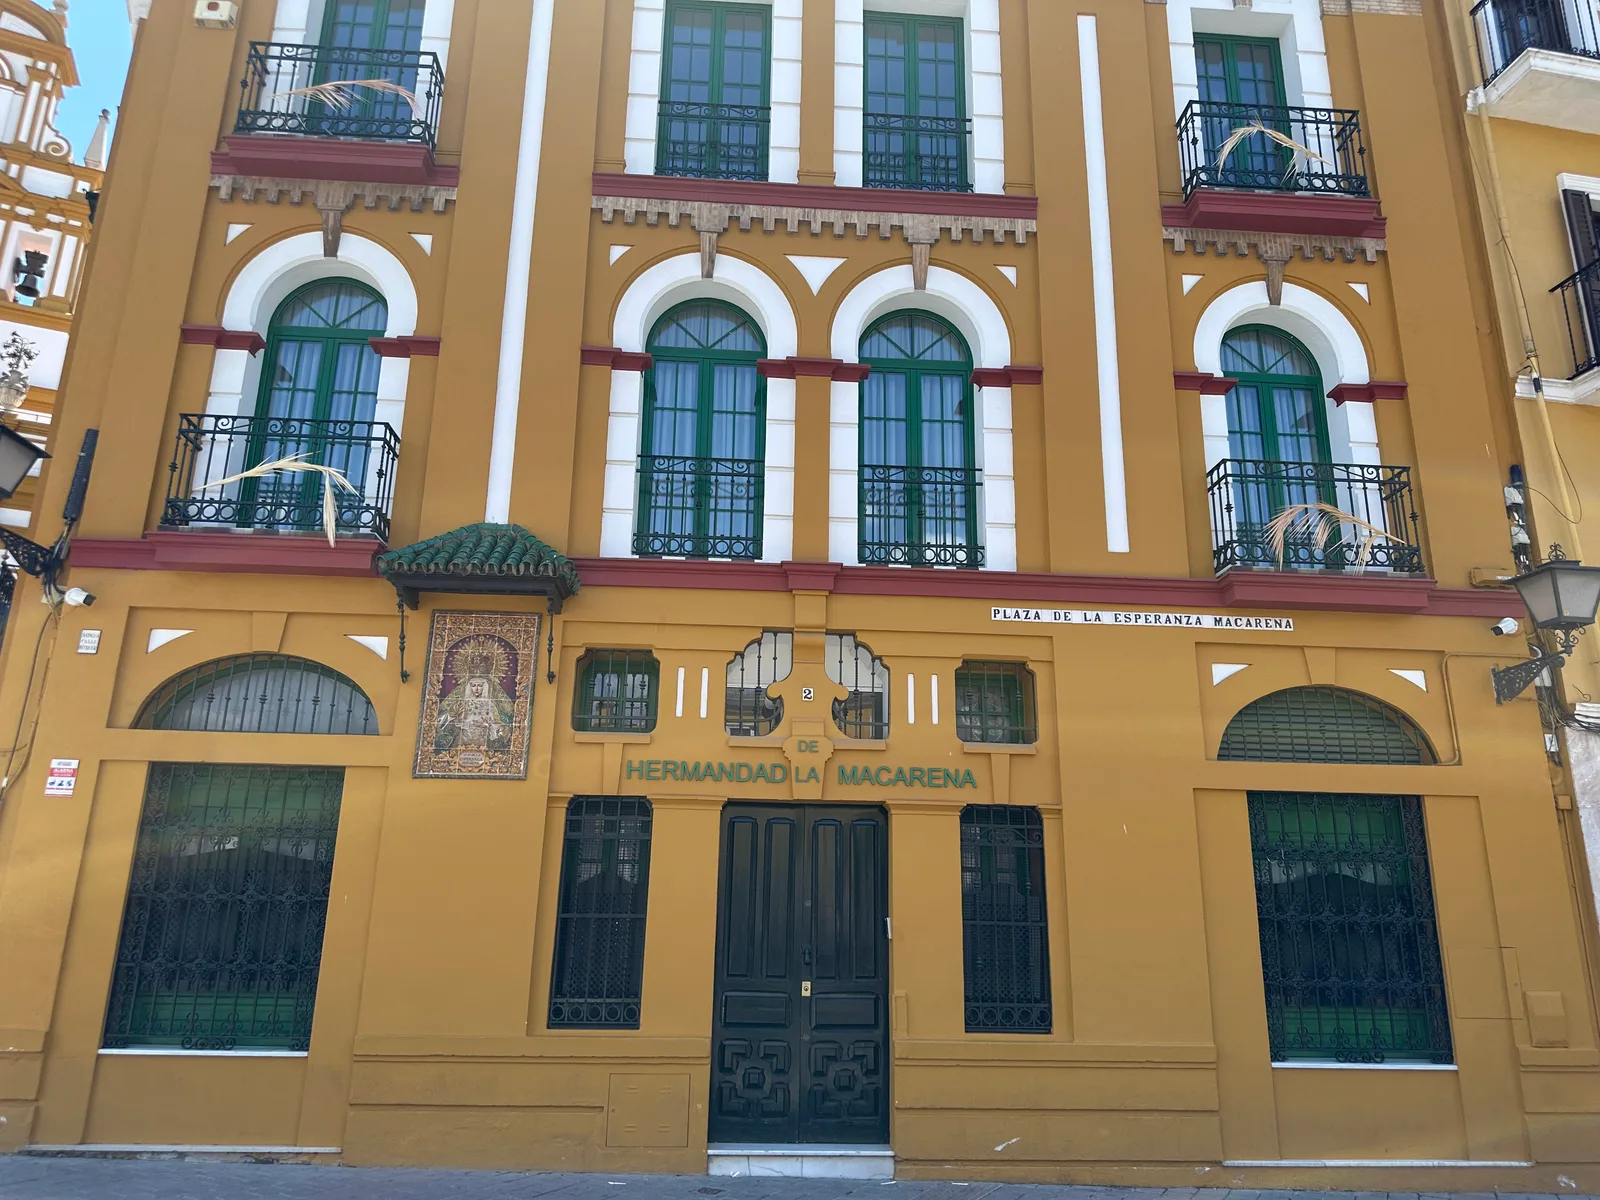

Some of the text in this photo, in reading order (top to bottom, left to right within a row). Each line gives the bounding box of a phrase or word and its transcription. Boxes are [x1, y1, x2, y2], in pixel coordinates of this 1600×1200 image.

[992, 608, 1293, 630] PLAZA DE LA ESPERANZA MACARENA
[803, 688, 813, 699] 2
[797, 739, 819, 753] DE
[626, 759, 978, 789] HERMANDAD LA MACARENA
